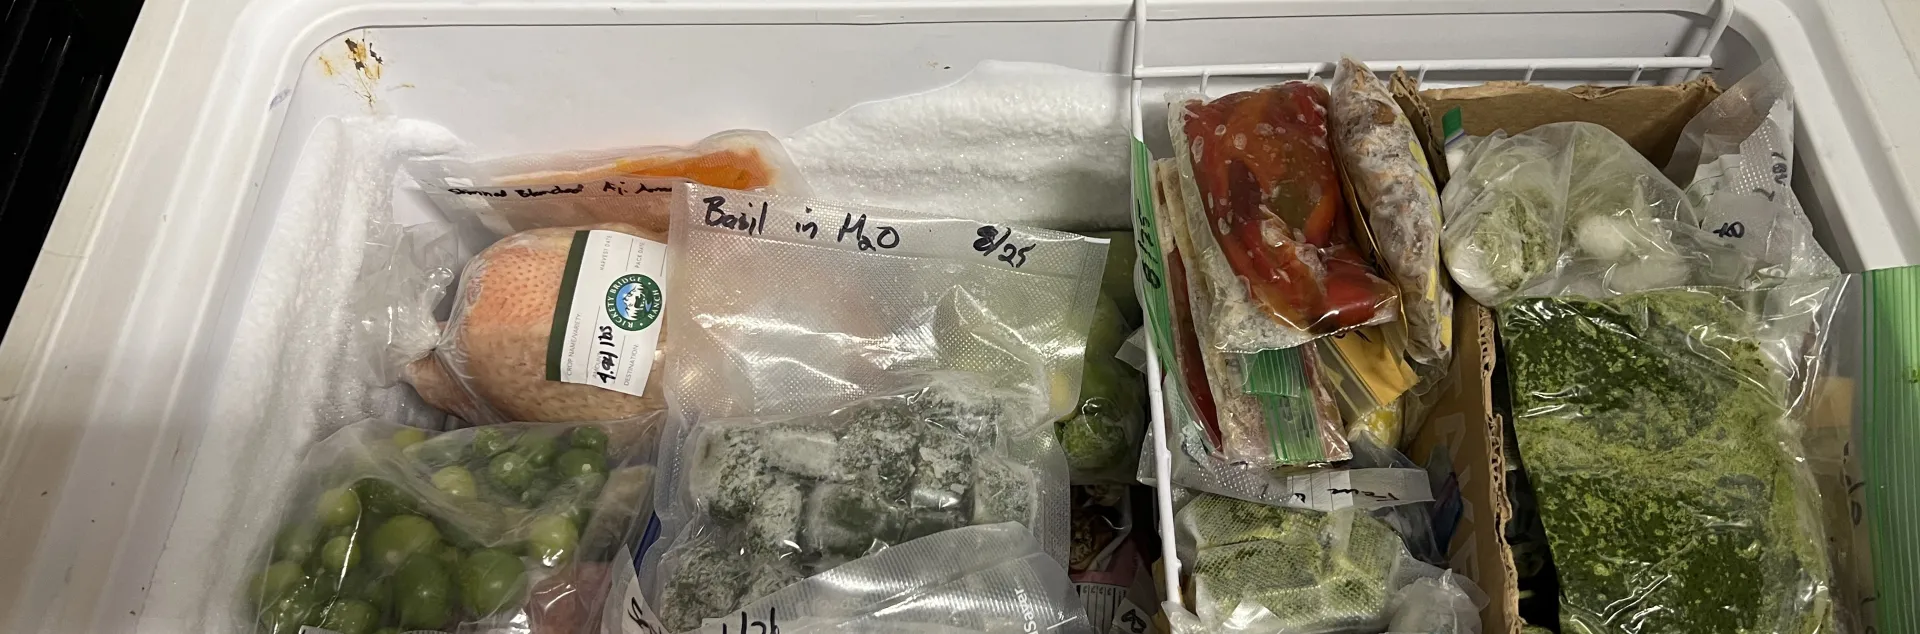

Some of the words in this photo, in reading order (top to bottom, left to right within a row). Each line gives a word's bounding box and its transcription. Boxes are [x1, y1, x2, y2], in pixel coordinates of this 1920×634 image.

[703, 196, 768, 236] Basil
[796, 206, 818, 239] in
[973, 225, 1037, 269] 8/25
[1137, 198, 1162, 290] 8/25
[634, 254, 643, 269] PACK
[609, 276, 642, 294] BRIDGE
[607, 295, 634, 329] RICKETY
[647, 289, 661, 320] RANCH
